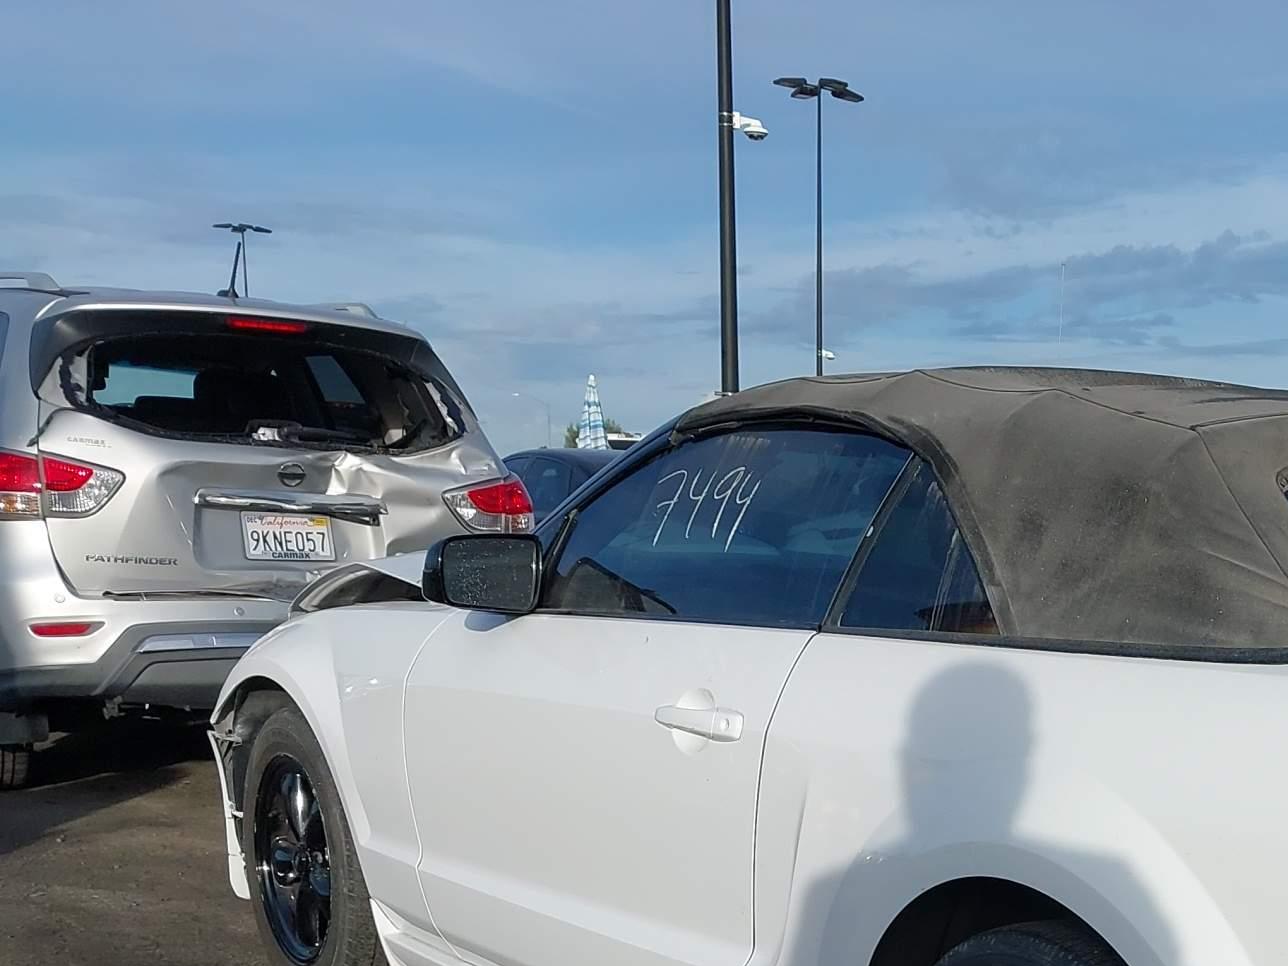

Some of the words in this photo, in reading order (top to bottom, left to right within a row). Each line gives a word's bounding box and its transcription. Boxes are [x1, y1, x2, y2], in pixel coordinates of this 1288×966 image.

[652, 466, 761, 553] 7494
[260, 515, 308, 529] California
[250, 530, 326, 553] 9KNE057
[85, 554, 179, 566] PATHFINDER
